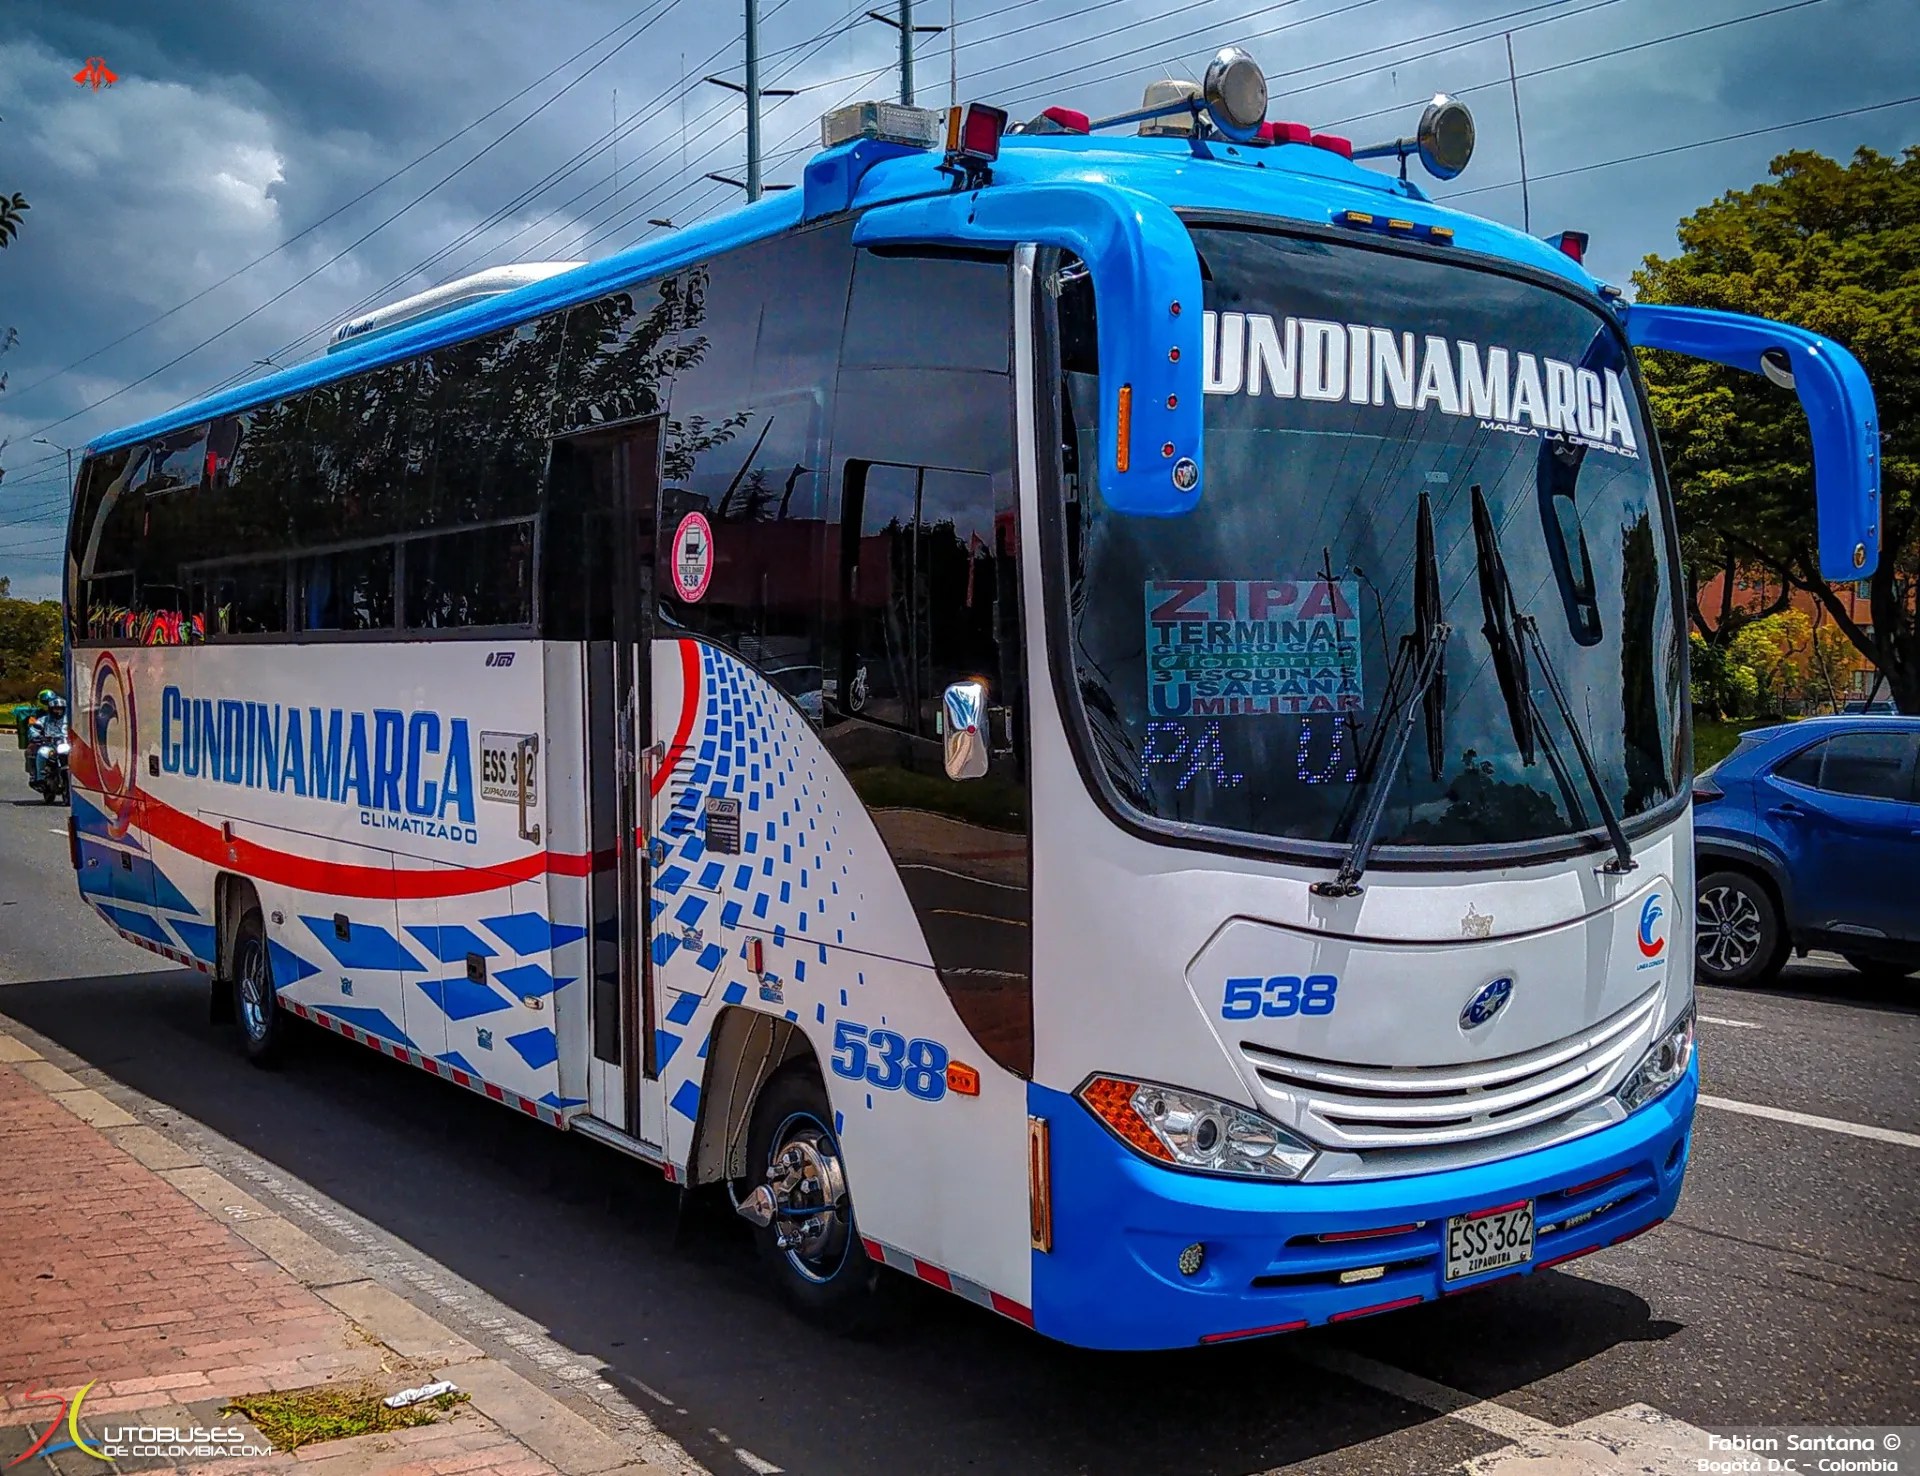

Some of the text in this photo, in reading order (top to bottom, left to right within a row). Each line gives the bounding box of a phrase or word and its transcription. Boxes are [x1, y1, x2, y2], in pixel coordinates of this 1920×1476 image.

[1203, 310, 1638, 450] UNDINAMARCA
[1480, 420, 1539, 438] MARCA
[1544, 430, 1565, 442] LA
[683, 575, 699, 587] 538
[1150, 582, 1356, 621] ZIPA
[1151, 621, 1357, 645] TERMINAL
[1154, 668, 1357, 682] 3 ESQUINAS
[1152, 679, 1362, 716] U SABANA
[1193, 695, 1362, 715] MILITAR
[161, 684, 477, 827] CUNDINAMARCA
[483, 749, 534, 787] ESS 32
[483, 786, 521, 799] ZIPAQUIR
[360, 809, 478, 846] CLIMATIZADO
[1221, 974, 1339, 1021] 538
[831, 1018, 949, 1102] 538
[1449, 1212, 1531, 1262] ESS 362
[1469, 1252, 1511, 1271] ZIPAQUIRA
